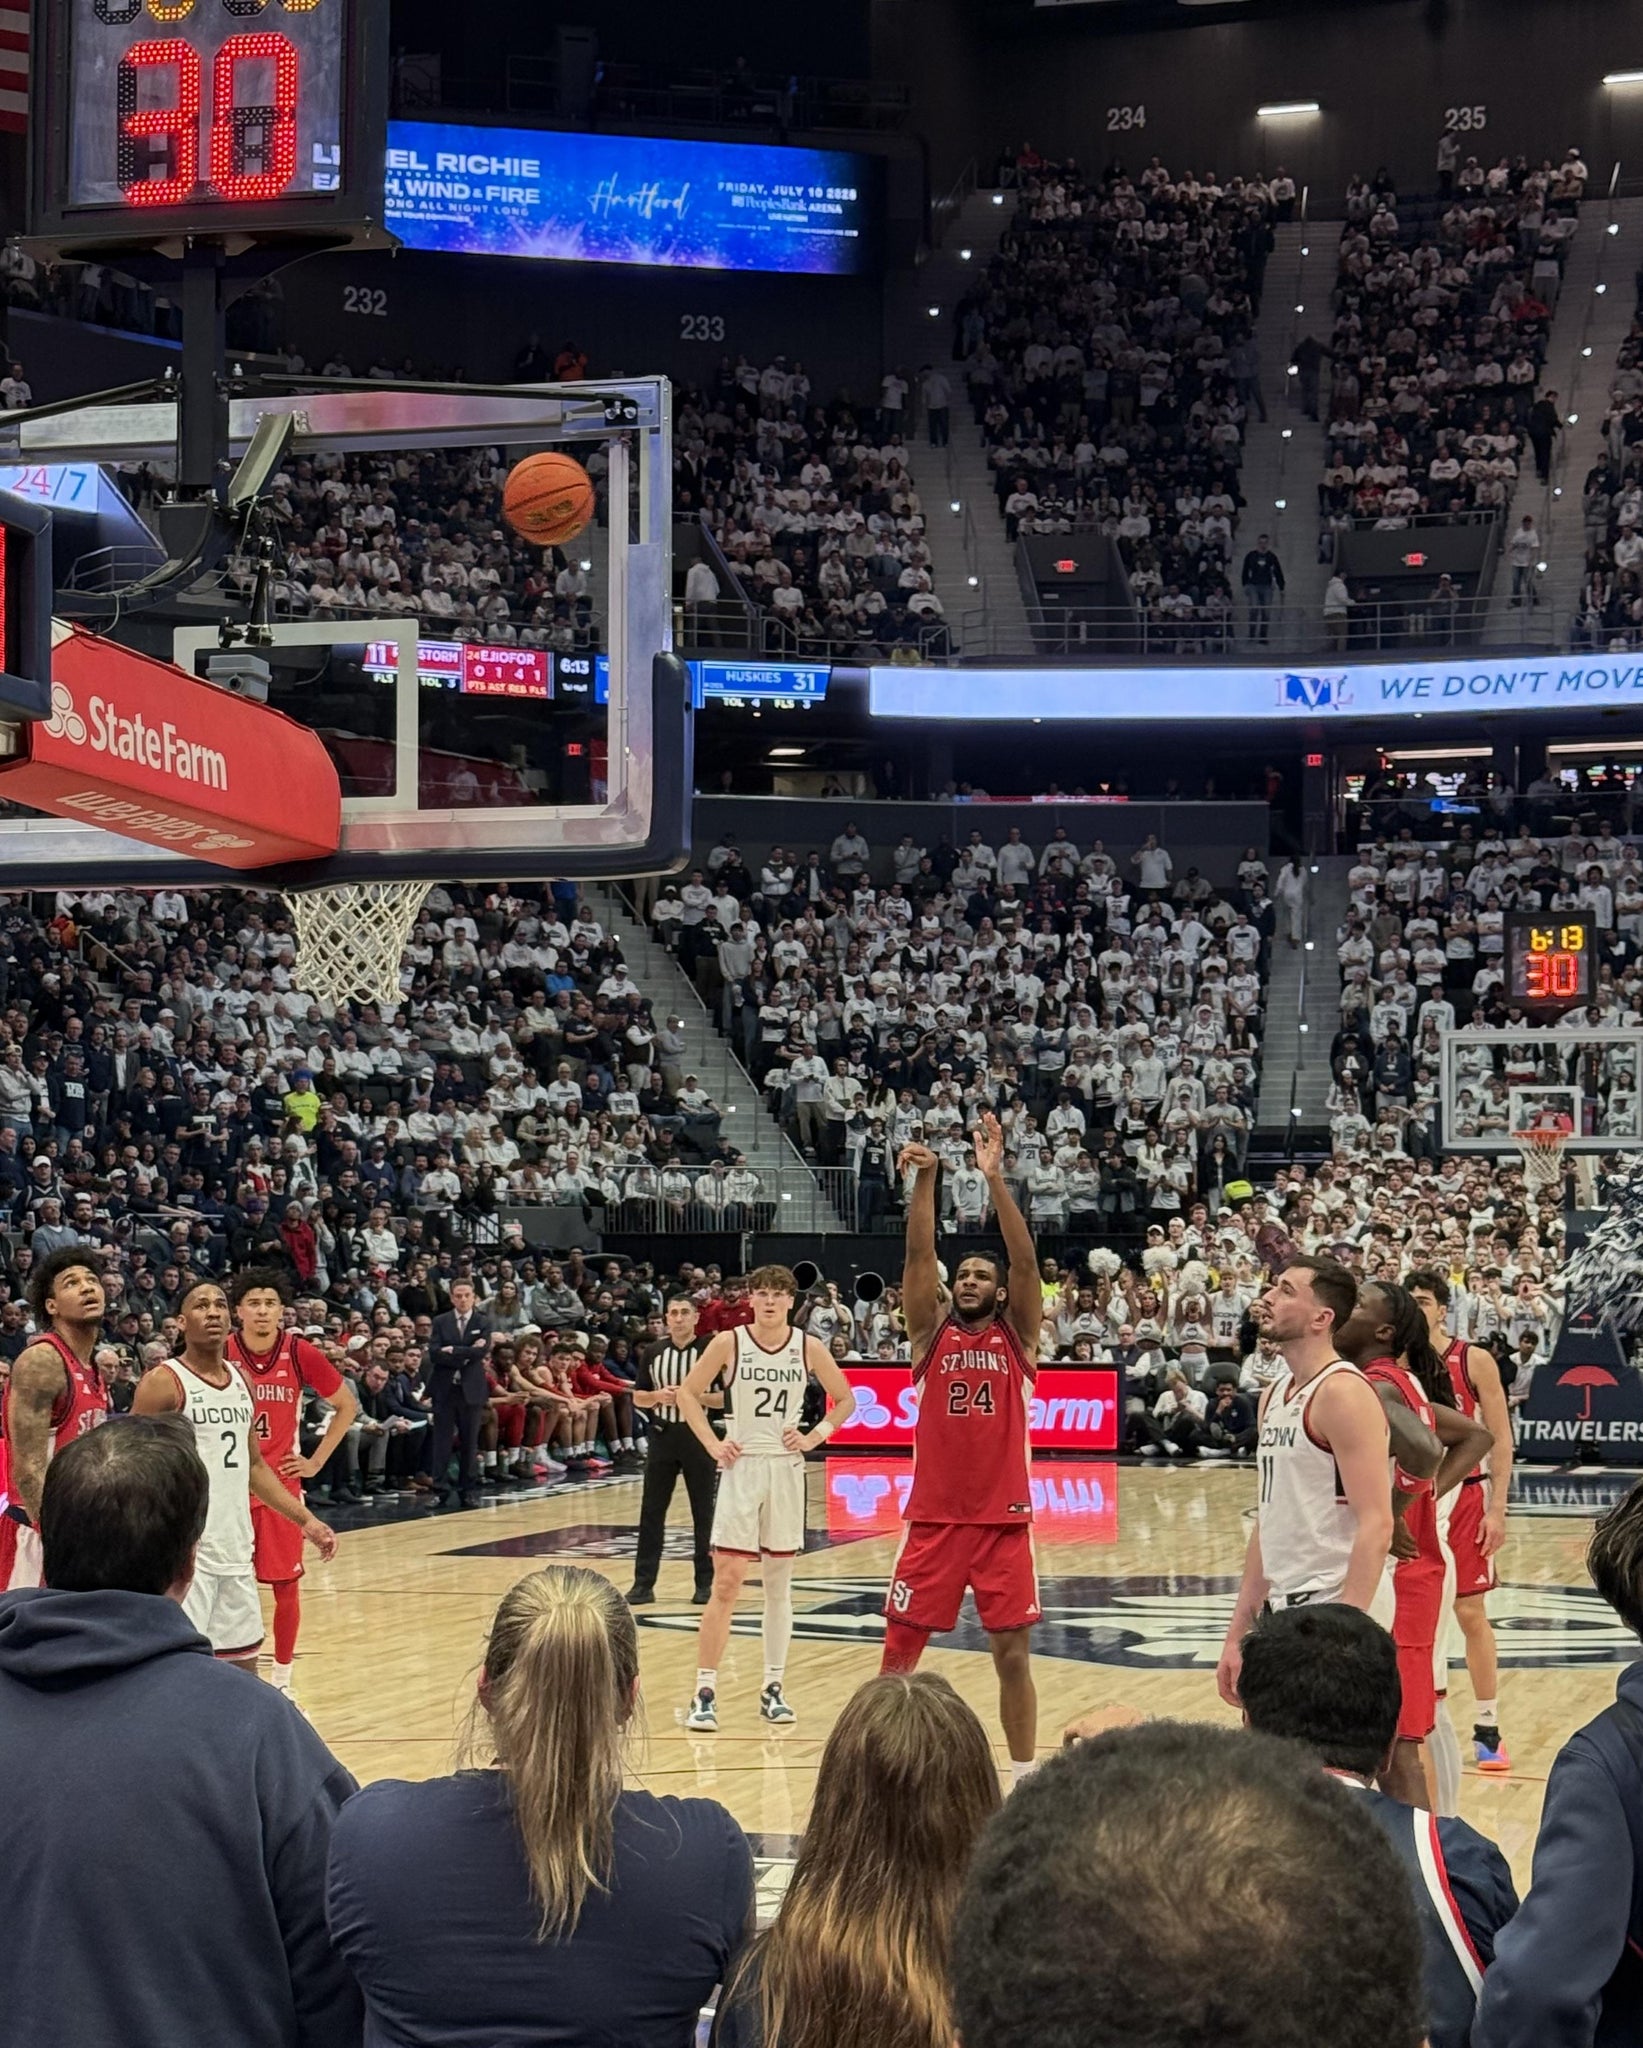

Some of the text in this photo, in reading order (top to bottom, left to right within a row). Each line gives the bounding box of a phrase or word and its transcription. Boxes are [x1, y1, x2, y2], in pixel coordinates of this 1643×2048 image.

[122, 33, 297, 206] 30
[1107, 105, 1145, 131] 234
[1444, 106, 1486, 131] 235
[436, 152, 541, 178] RICHIE
[404, 179, 471, 200] WIND
[472, 188, 483, 199] &
[485, 185, 541, 204] FIRE
[587, 171, 690, 220] Hartford
[718, 182, 768, 195] FRIDAY,
[772, 185, 804, 197] JULY
[808, 187, 823, 198] 10
[386, 198, 529, 217] ONG ALL NIGHT LONG
[808, 203, 843, 214] ARENA
[344, 286, 387, 316] 232
[681, 314, 725, 341] 233
[12, 464, 88, 502] 24/7
[418, 648, 458, 663] STORM
[466, 649, 535, 666] 24 EJIOFOR
[560, 657, 589, 675] 6:13
[373, 673, 394, 684] FLS
[421, 677, 442, 689] TOL
[473, 665, 541, 682] 0 1 4 1
[726, 670, 816, 692] HUSKIES 31
[1381, 677, 1433, 700] WE
[1442, 671, 1548, 697] DON'T
[722, 697, 746, 708] TOL
[751, 699, 761, 708] 4
[774, 699, 796, 709] FLS
[1531, 925, 1584, 951] 6:13
[1525, 953, 1579, 998] 30
[1219, 1320, 1233, 1337] 32
[741, 1367, 803, 1382] UCONN
[961, 1349, 1009, 1376] JOHN'S
[257, 1383, 295, 1404] OHN'S
[754, 1387, 788, 1419] 24
[947, 1380, 995, 1417] 24
[192, 1407, 252, 1425] UCONN
[254, 1411, 271, 1440] 4
[1029, 1397, 1104, 1430] arm
[220, 1430, 239, 1469] 2
[1261, 1455, 1274, 1503] 11
